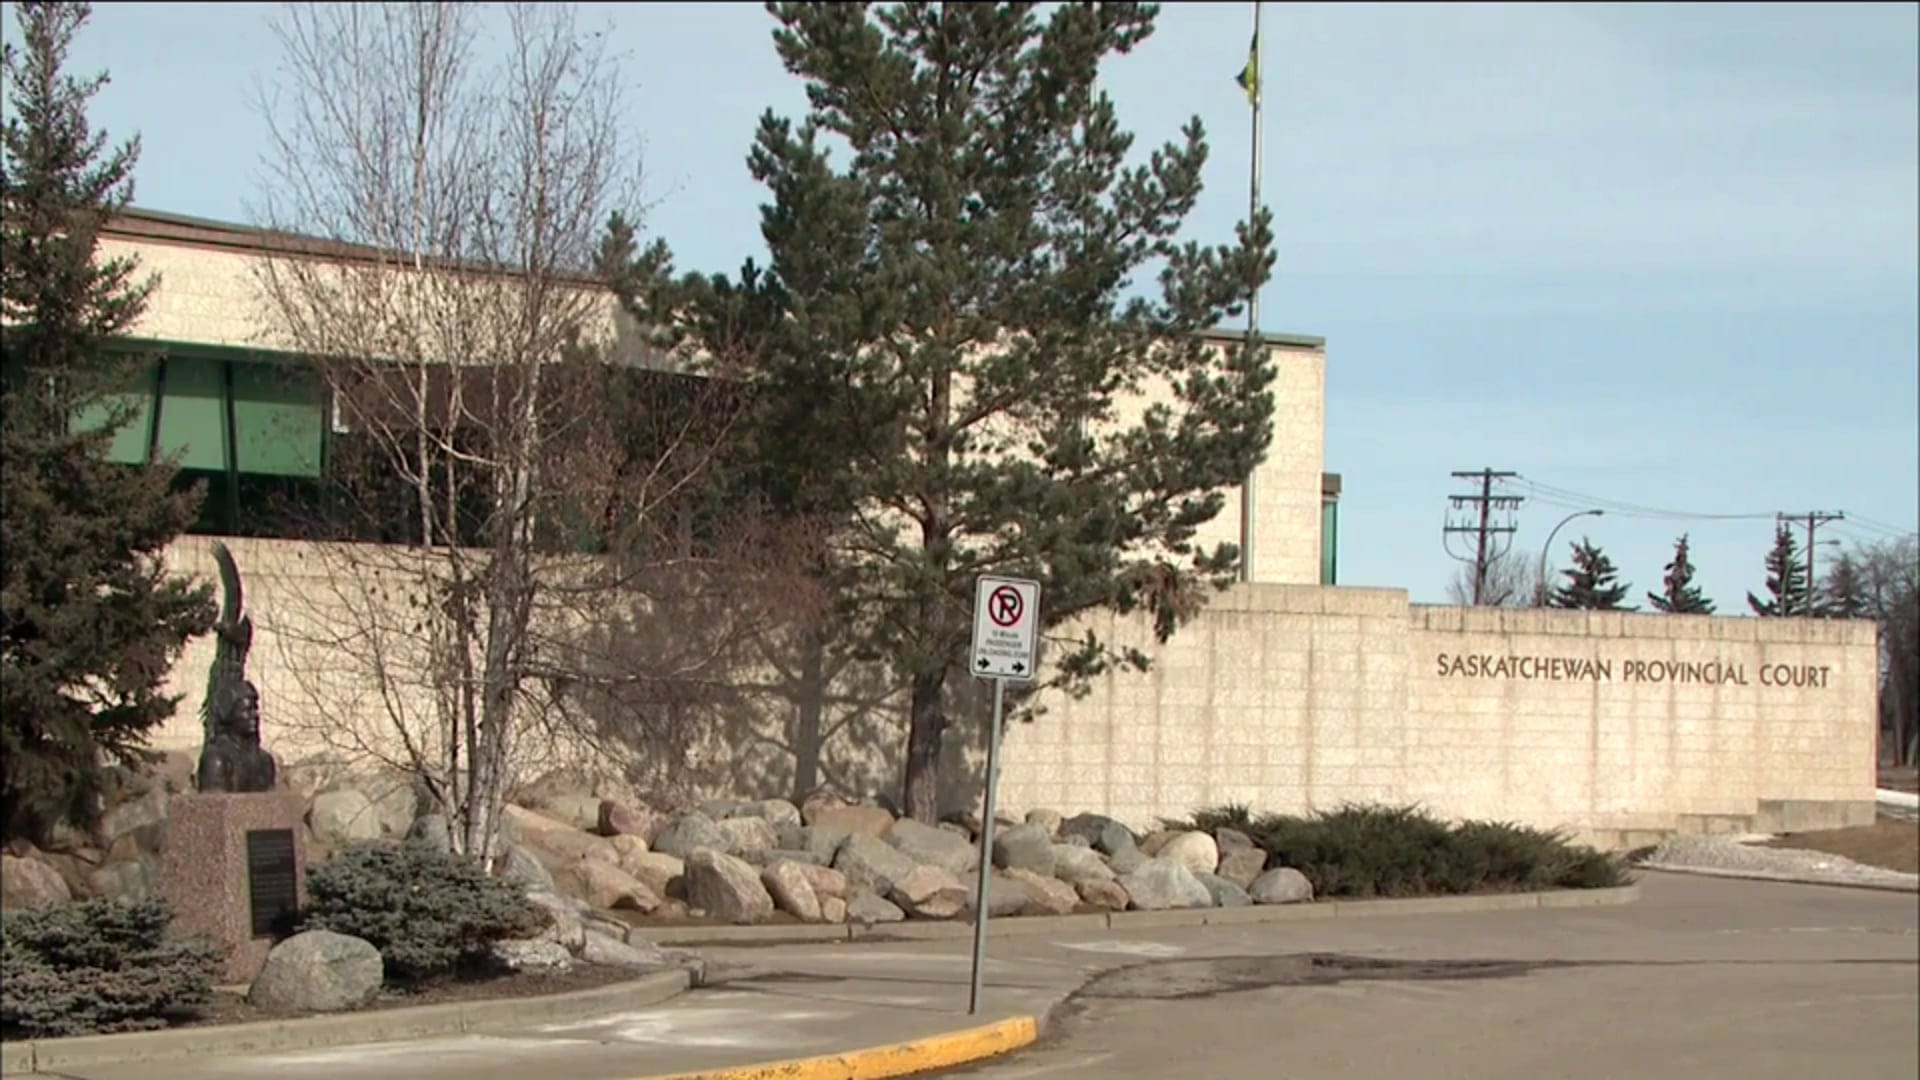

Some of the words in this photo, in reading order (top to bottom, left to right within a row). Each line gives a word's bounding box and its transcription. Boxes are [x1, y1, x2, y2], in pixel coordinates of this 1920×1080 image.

[1437, 653, 1611, 681] SASKATCHEWAN
[1623, 660, 1748, 685] PROVINCIAL
[1759, 663, 1830, 688] COURT
